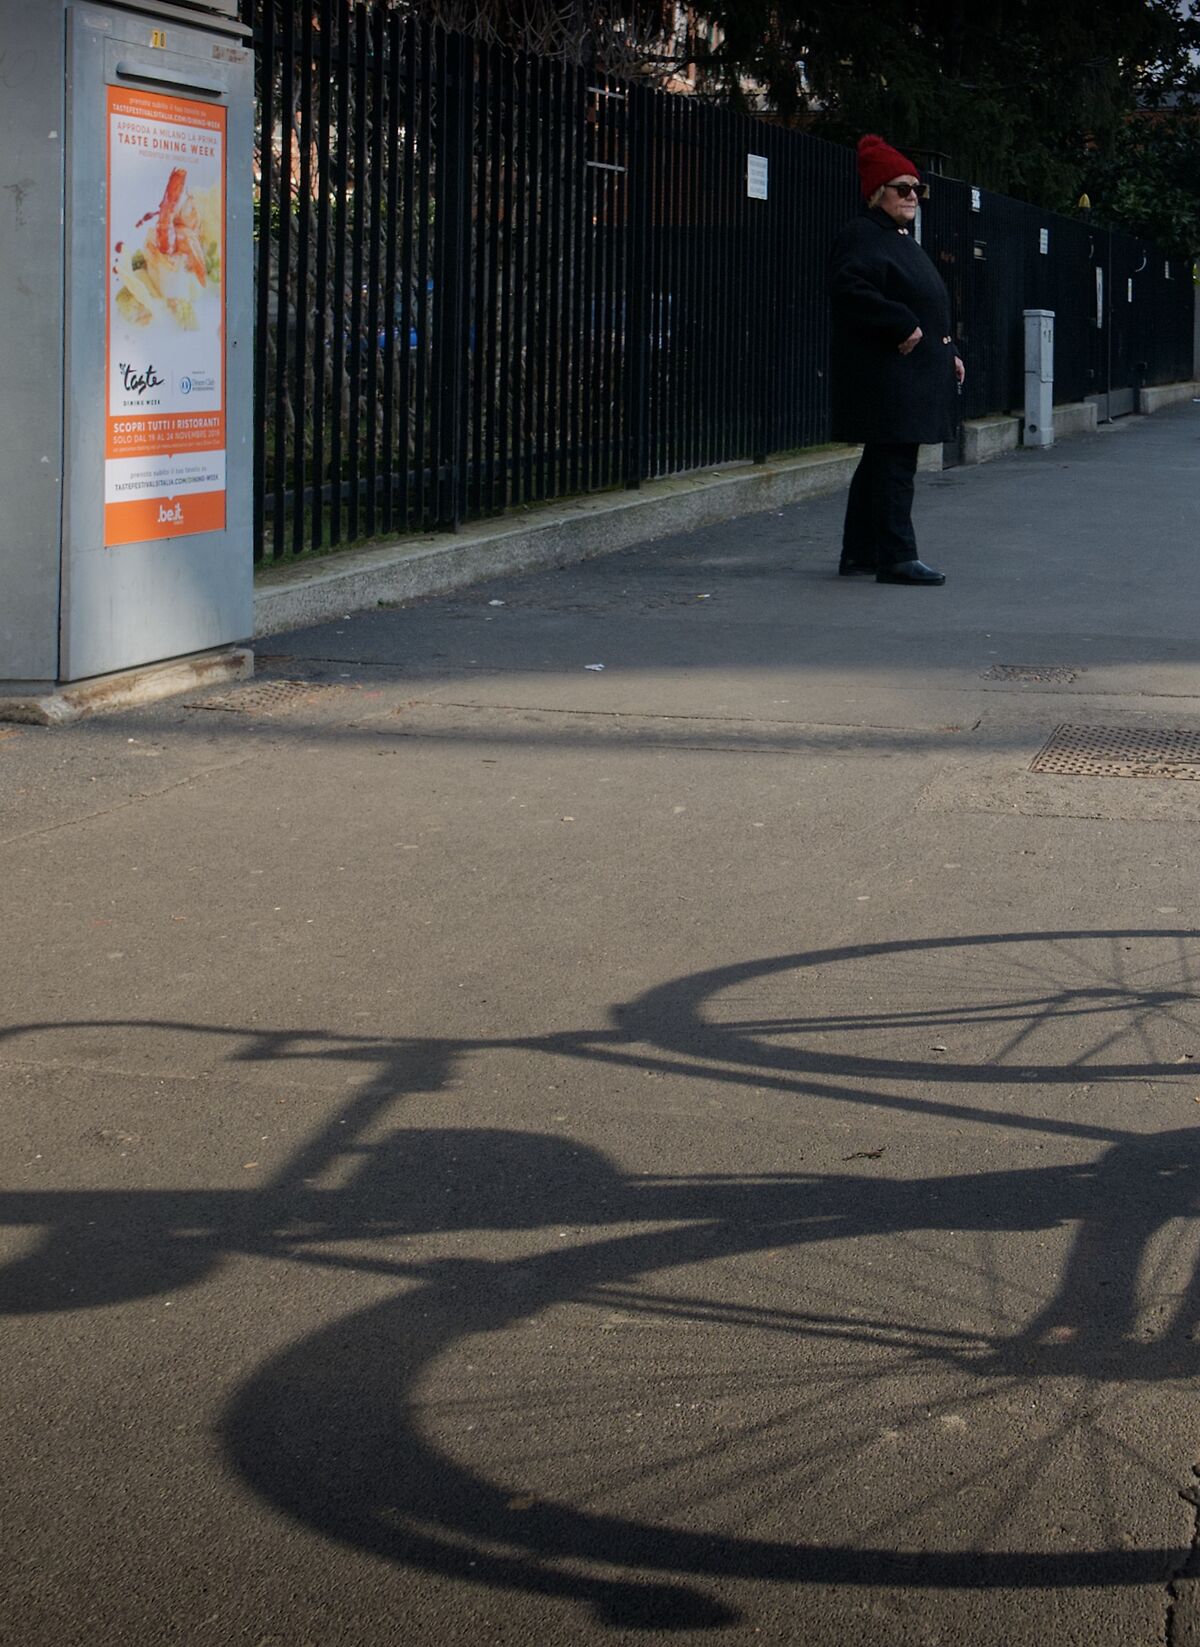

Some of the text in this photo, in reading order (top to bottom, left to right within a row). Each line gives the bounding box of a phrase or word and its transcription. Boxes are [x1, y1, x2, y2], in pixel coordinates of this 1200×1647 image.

[160, 128, 186, 139] MILANO
[118, 133, 148, 147] TASTE
[153, 138, 187, 153] DINING
[191, 144, 216, 157] WEEK
[124, 364, 165, 395] taste
[113, 423, 145, 433] SCOPRI
[147, 420, 170, 431] TUTTI
[177, 417, 220, 429] RISTORANTI
[113, 435, 133, 445] SOLO
[134, 434, 147, 443] DAL
[157, 432, 165, 441] AL
[175, 430, 207, 440] NOVEMBRE
